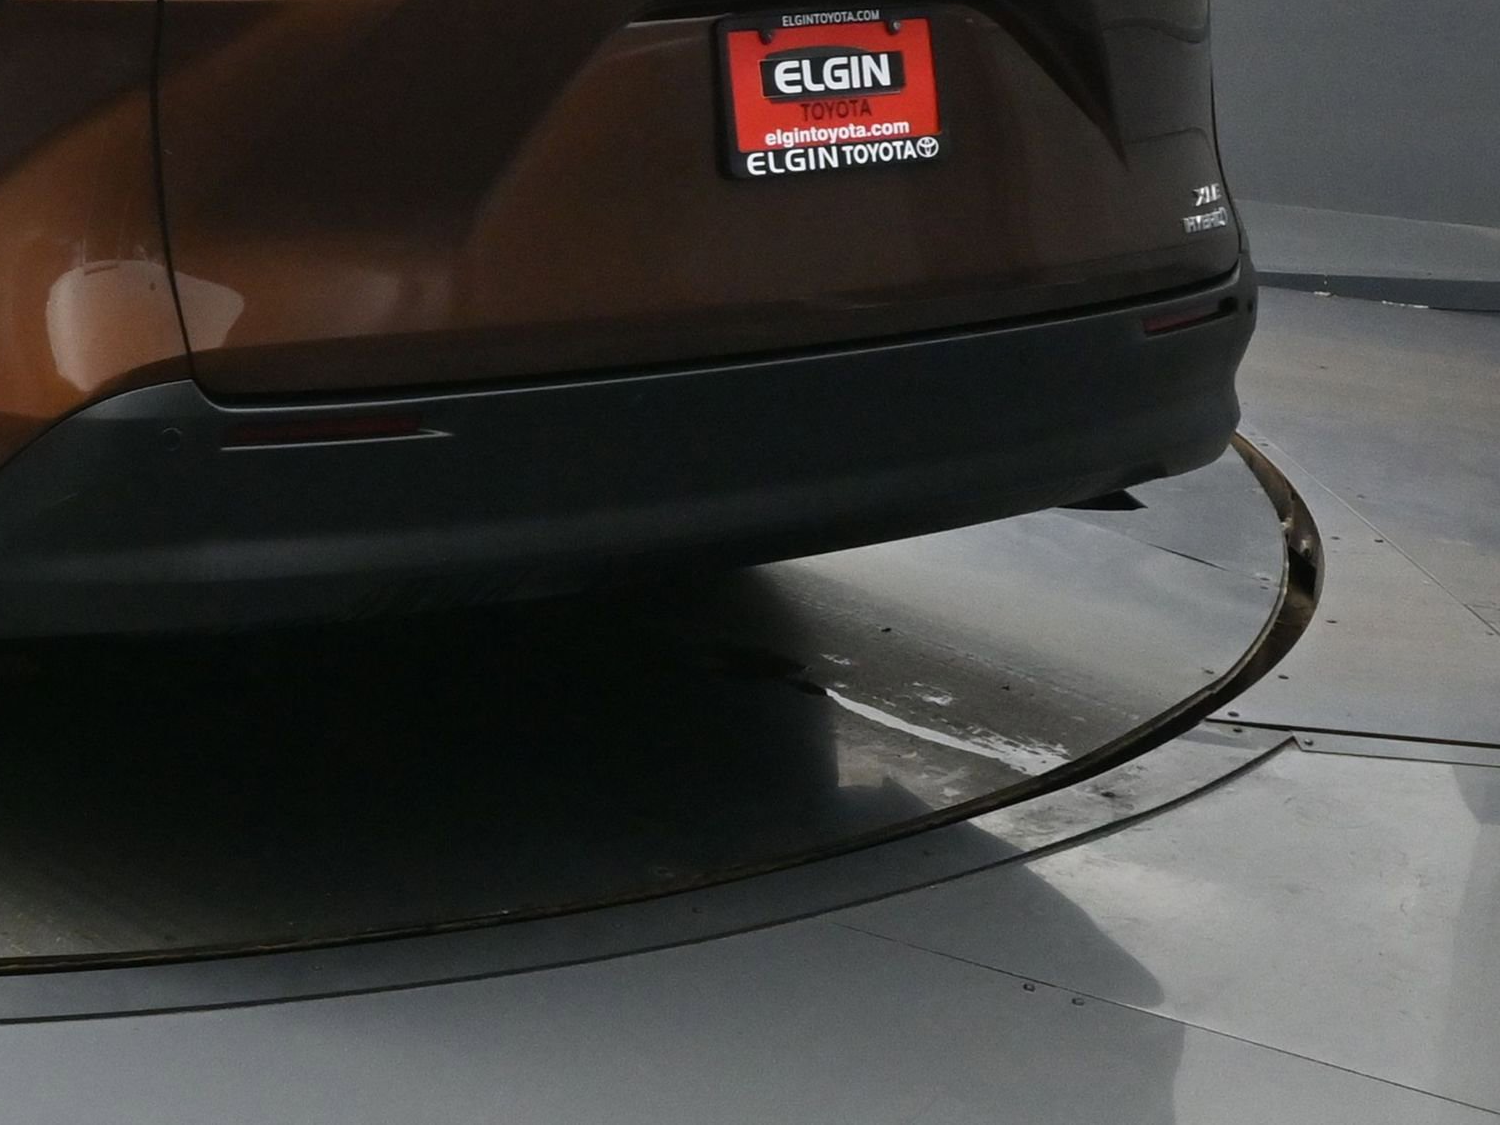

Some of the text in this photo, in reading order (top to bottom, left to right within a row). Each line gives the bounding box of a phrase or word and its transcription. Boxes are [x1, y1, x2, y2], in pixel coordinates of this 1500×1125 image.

[782, 9, 880, 27] ELGINTOYOTA.COM
[774, 53, 891, 94] ELGIN
[801, 99, 872, 122] TOYOTA
[765, 121, 910, 147] elgintoyota.com
[747, 139, 917, 175] ELGIN TOYOTA
